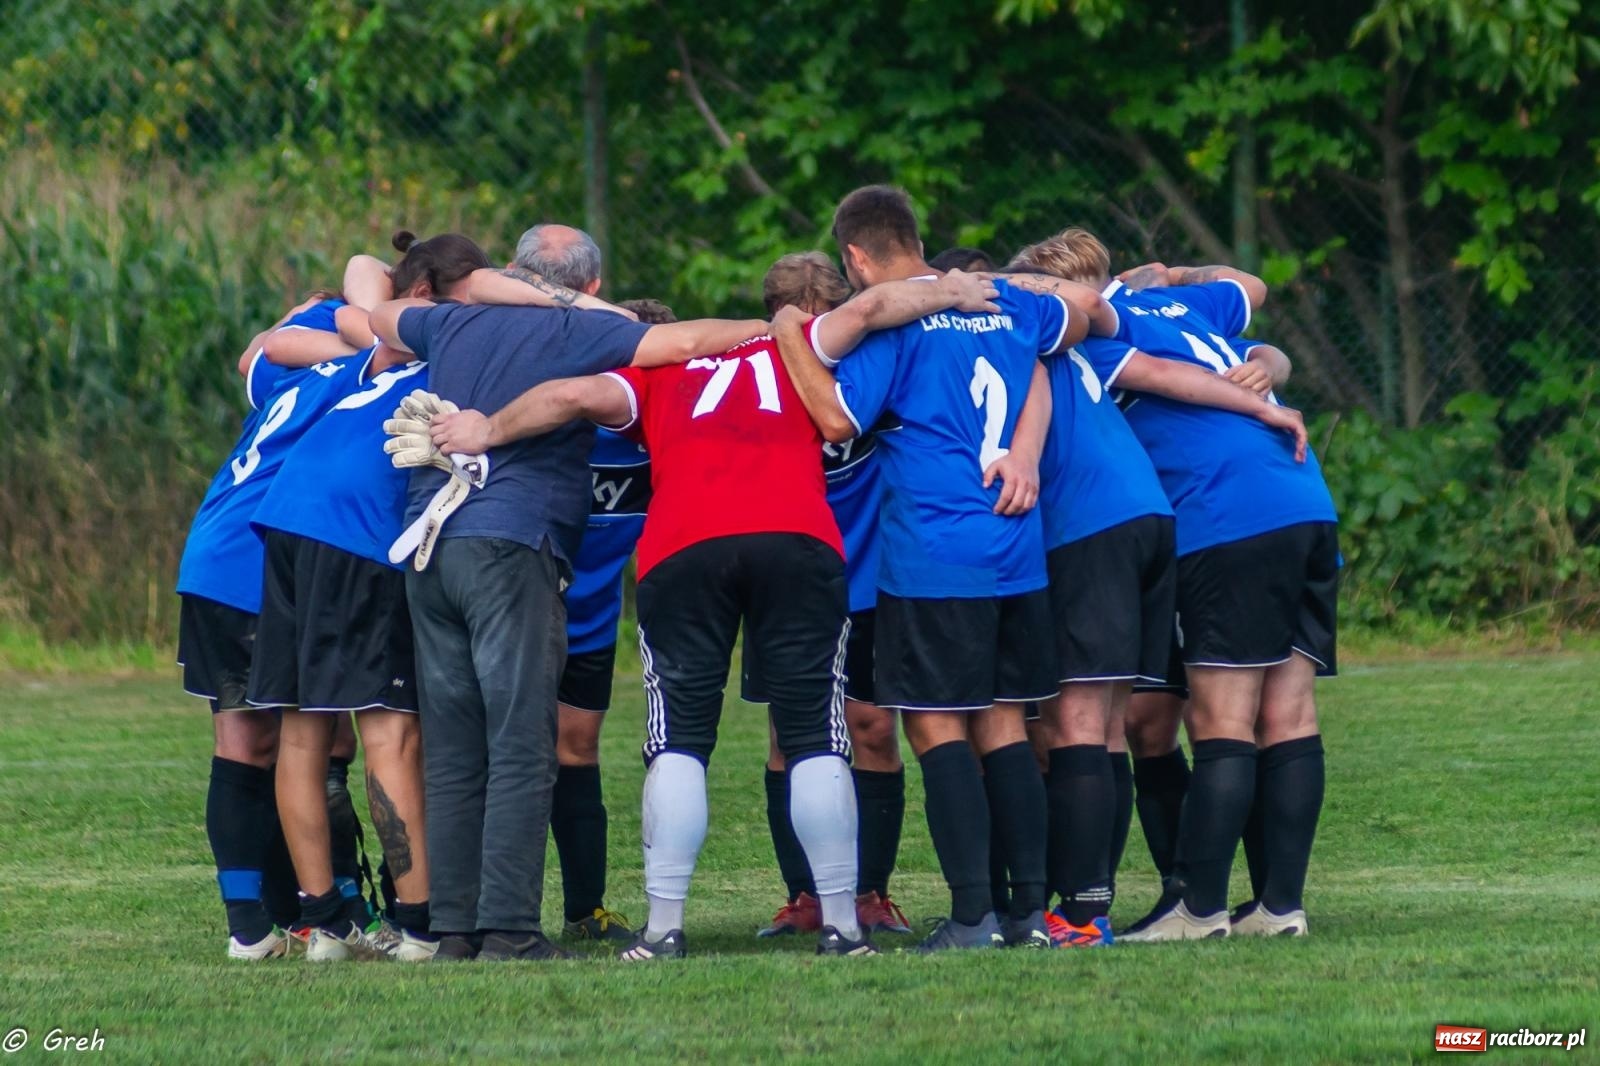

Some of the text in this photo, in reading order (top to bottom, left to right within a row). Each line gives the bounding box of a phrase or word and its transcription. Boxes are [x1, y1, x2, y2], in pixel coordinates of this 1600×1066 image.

[921, 314, 951, 332] LKS
[685, 350, 782, 419] 71
[592, 472, 633, 510] ky
